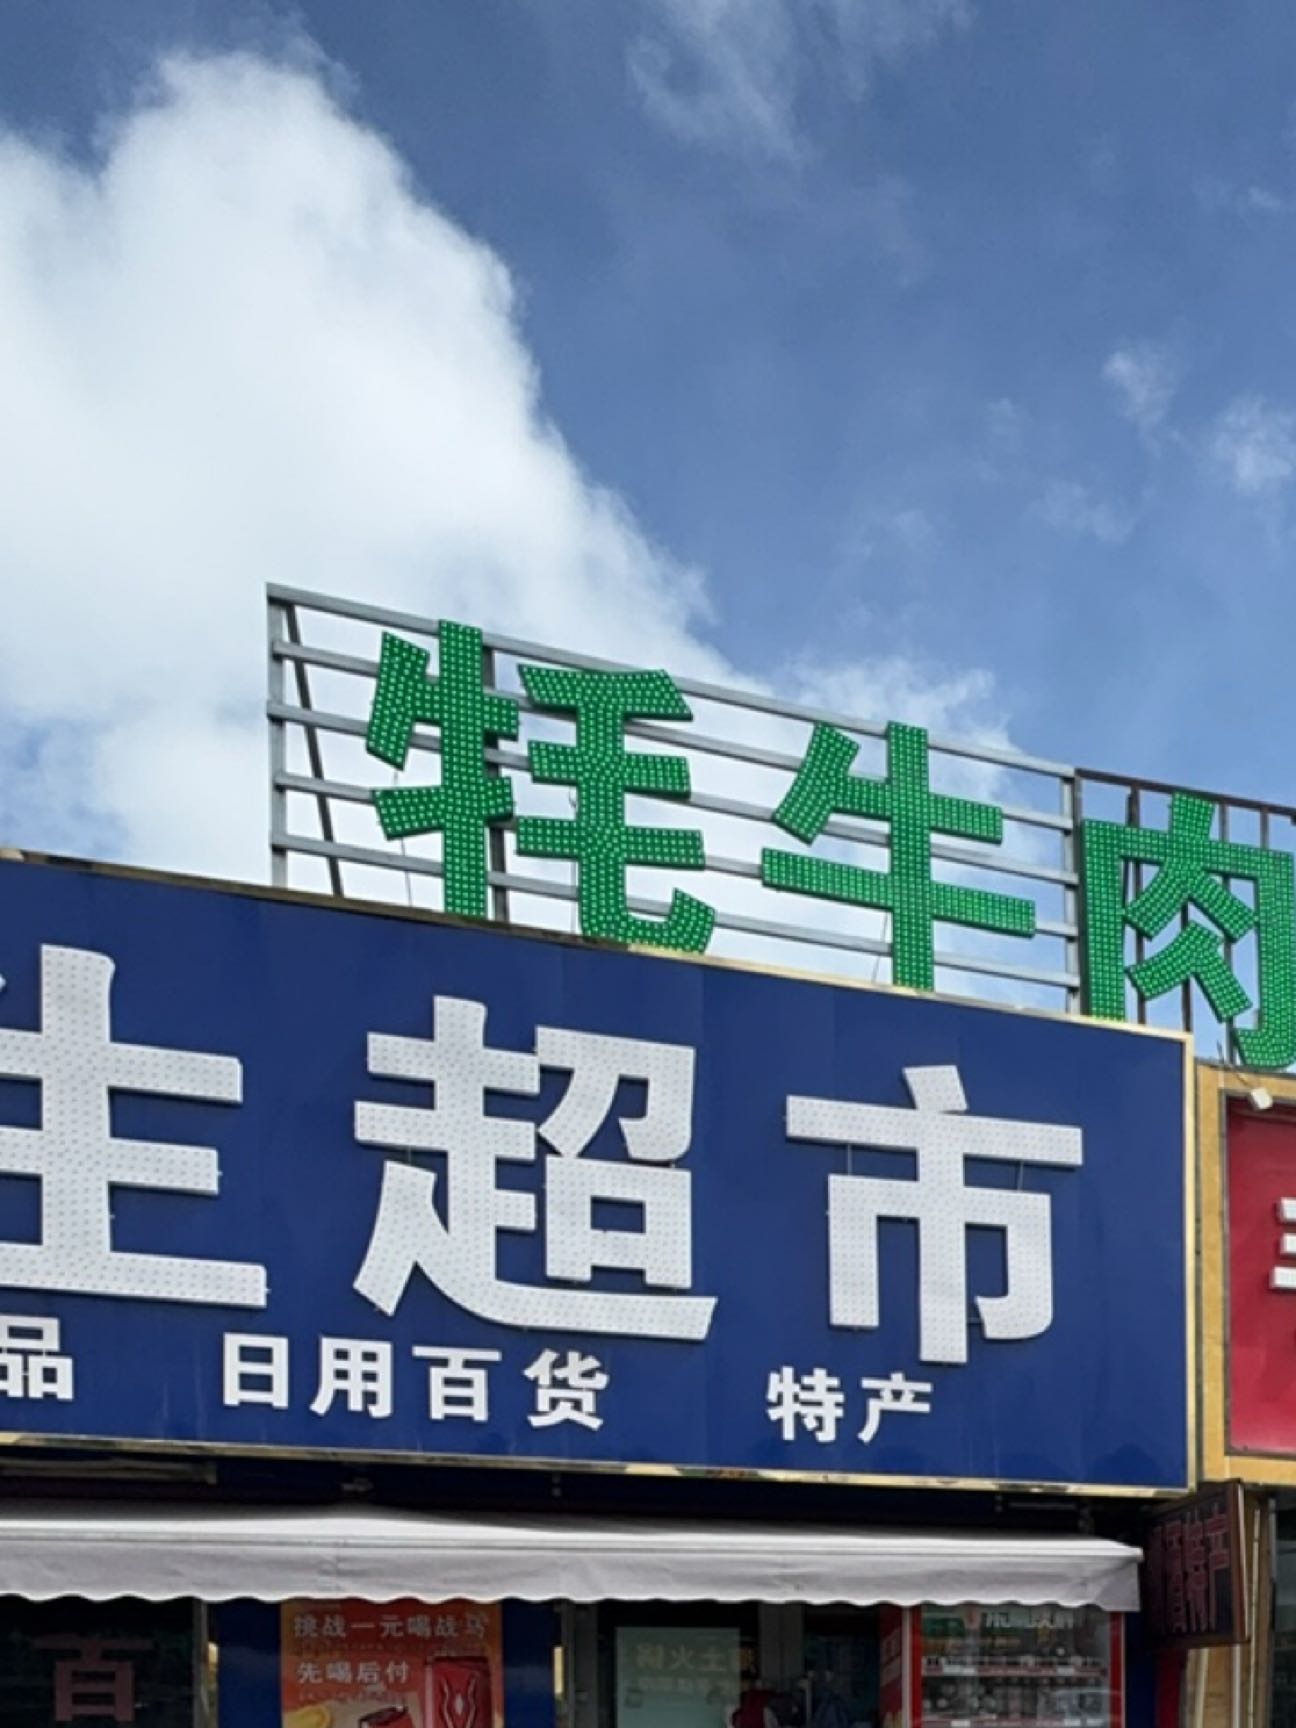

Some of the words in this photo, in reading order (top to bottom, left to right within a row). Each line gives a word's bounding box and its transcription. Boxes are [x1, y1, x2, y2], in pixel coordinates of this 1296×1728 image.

[0, 943, 1083, 1365] 生超市
[223, 1332, 610, 1429] 日用百货
[766, 1366, 933, 1443] 特产
[297, 1661, 410, 1685] 先喝后付
